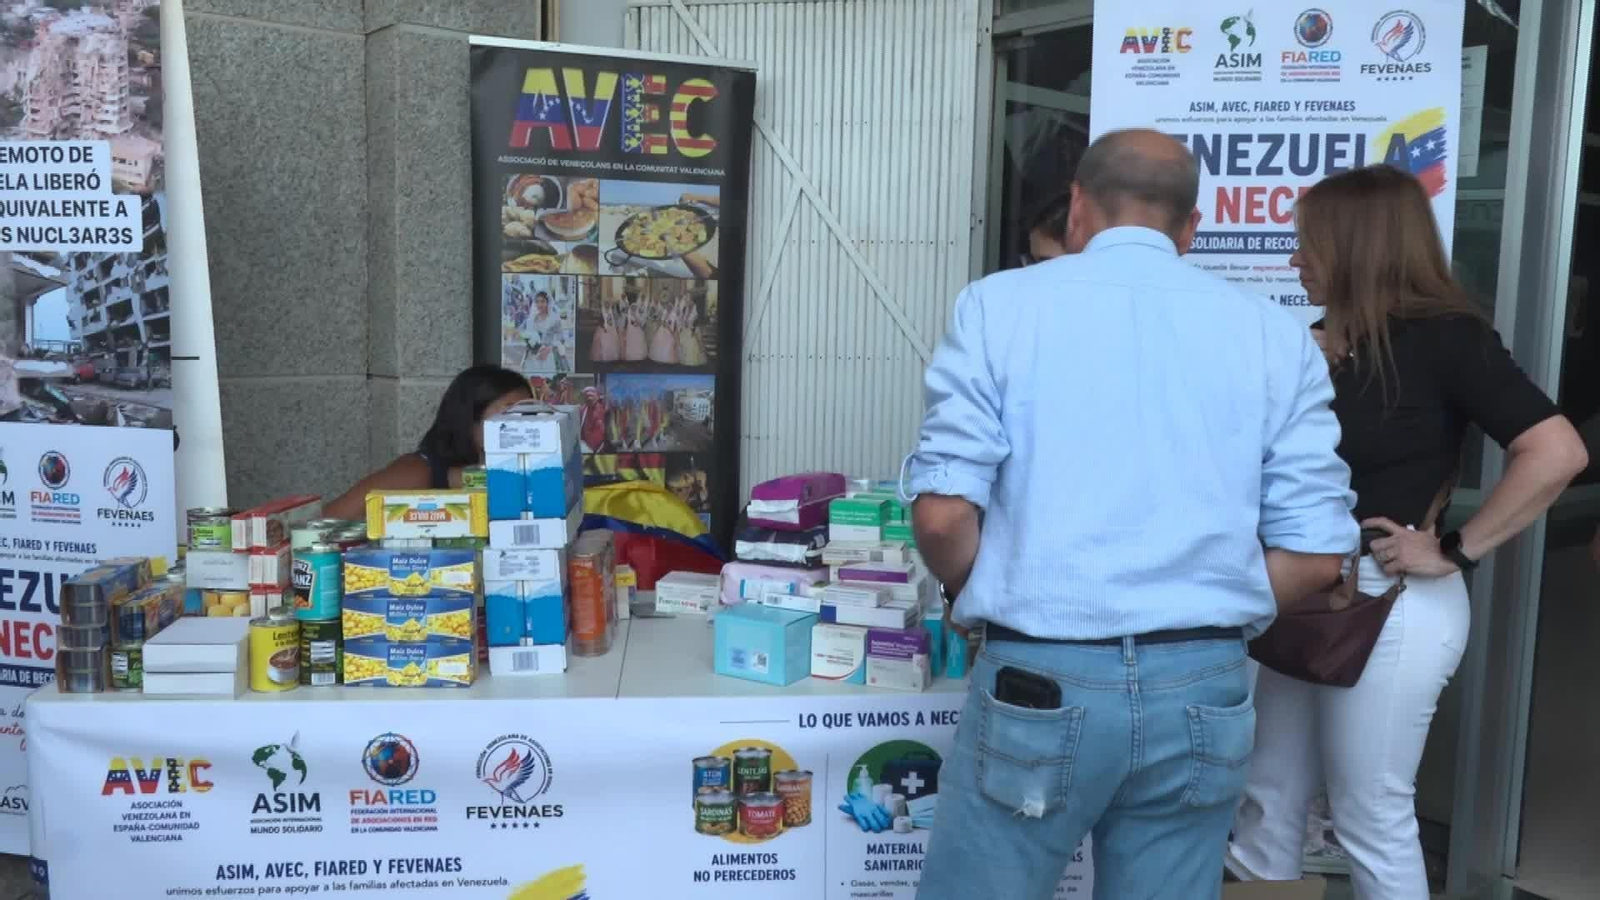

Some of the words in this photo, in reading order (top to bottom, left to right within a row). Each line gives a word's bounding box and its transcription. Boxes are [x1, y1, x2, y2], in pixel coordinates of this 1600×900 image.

[1119, 26, 1193, 53] AVEC
[1215, 53, 1262, 68] ASIM
[1280, 51, 1341, 63] FIARED
[1360, 63, 1431, 74] FEVENAES
[509, 67, 719, 158] AVEC
[1189, 101, 1218, 113] ASIM,
[1222, 101, 1250, 112] AVEC,
[1254, 101, 1290, 112] FIARED
[1294, 101, 1301, 112] Y
[1305, 101, 1356, 112] FEVENAES
[70, 147, 93, 163] DE
[1170, 133, 1412, 176] NEZUELA
[548, 158, 559, 166] DE
[624, 163, 635, 171] LA
[636, 164, 678, 174] COMUNITAT
[679, 166, 726, 176] VALENCIANA
[33, 169, 100, 190] LIBERÓ
[115, 201, 128, 217] A
[1215, 186, 1308, 224] NEC
[17, 226, 133, 244] NUCL3AR3S
[1189, 236, 1244, 250] SOLIDARIA
[1247, 237, 1262, 250] DE
[1264, 237, 1299, 250] RECOG
[31, 491, 80, 505] FIARED
[97, 508, 154, 522] FEVENAES
[13, 538, 42, 550] FIARED
[45, 541, 51, 551] Y
[53, 541, 97, 554] FEVENAES
[0, 568, 69, 615] EZU
[0, 619, 54, 660] NEC
[20, 671, 31, 684] DE
[799, 713, 817, 728] LO
[823, 712, 852, 728] QUE
[858, 711, 909, 727] VAMOS
[915, 711, 925, 726] A
[102, 756, 214, 796] AVEC
[130, 799, 183, 809] ASOCIACIÓN
[251, 792, 321, 814] ASIM
[350, 789, 436, 805] FIARED
[121, 811, 178, 821] VENEZOLANA
[179, 811, 191, 820] EN
[466, 804, 564, 819] FEVENAES
[113, 821, 200, 832] ESPAÑA-COMUNIDAD
[250, 826, 280, 834] MUNDO
[282, 825, 323, 834] SOLIDARIO
[131, 834, 183, 842] VALENCIANA
[867, 842, 926, 855] MATERIAL
[711, 853, 778, 866] ALIMENTOS
[216, 863, 259, 881] ASIM,
[265, 861, 308, 879] AVEC,
[314, 859, 367, 877] FIARED
[373, 859, 382, 874] Y
[388, 857, 462, 874] FEVENAES
[693, 870, 710, 883] NO
[714, 869, 796, 882] PERECEDEROS
[166, 887, 202, 896] unimos
[205, 884, 255, 895] esfuerzos
[258, 885, 281, 896] para
[284, 884, 320, 896] apoyar
[333, 881, 346, 891] las
[349, 879, 387, 890] familias
[389, 878, 439, 889] afectadas
[441, 879, 454, 888] en
[456, 876, 510, 887] Venezuela.
